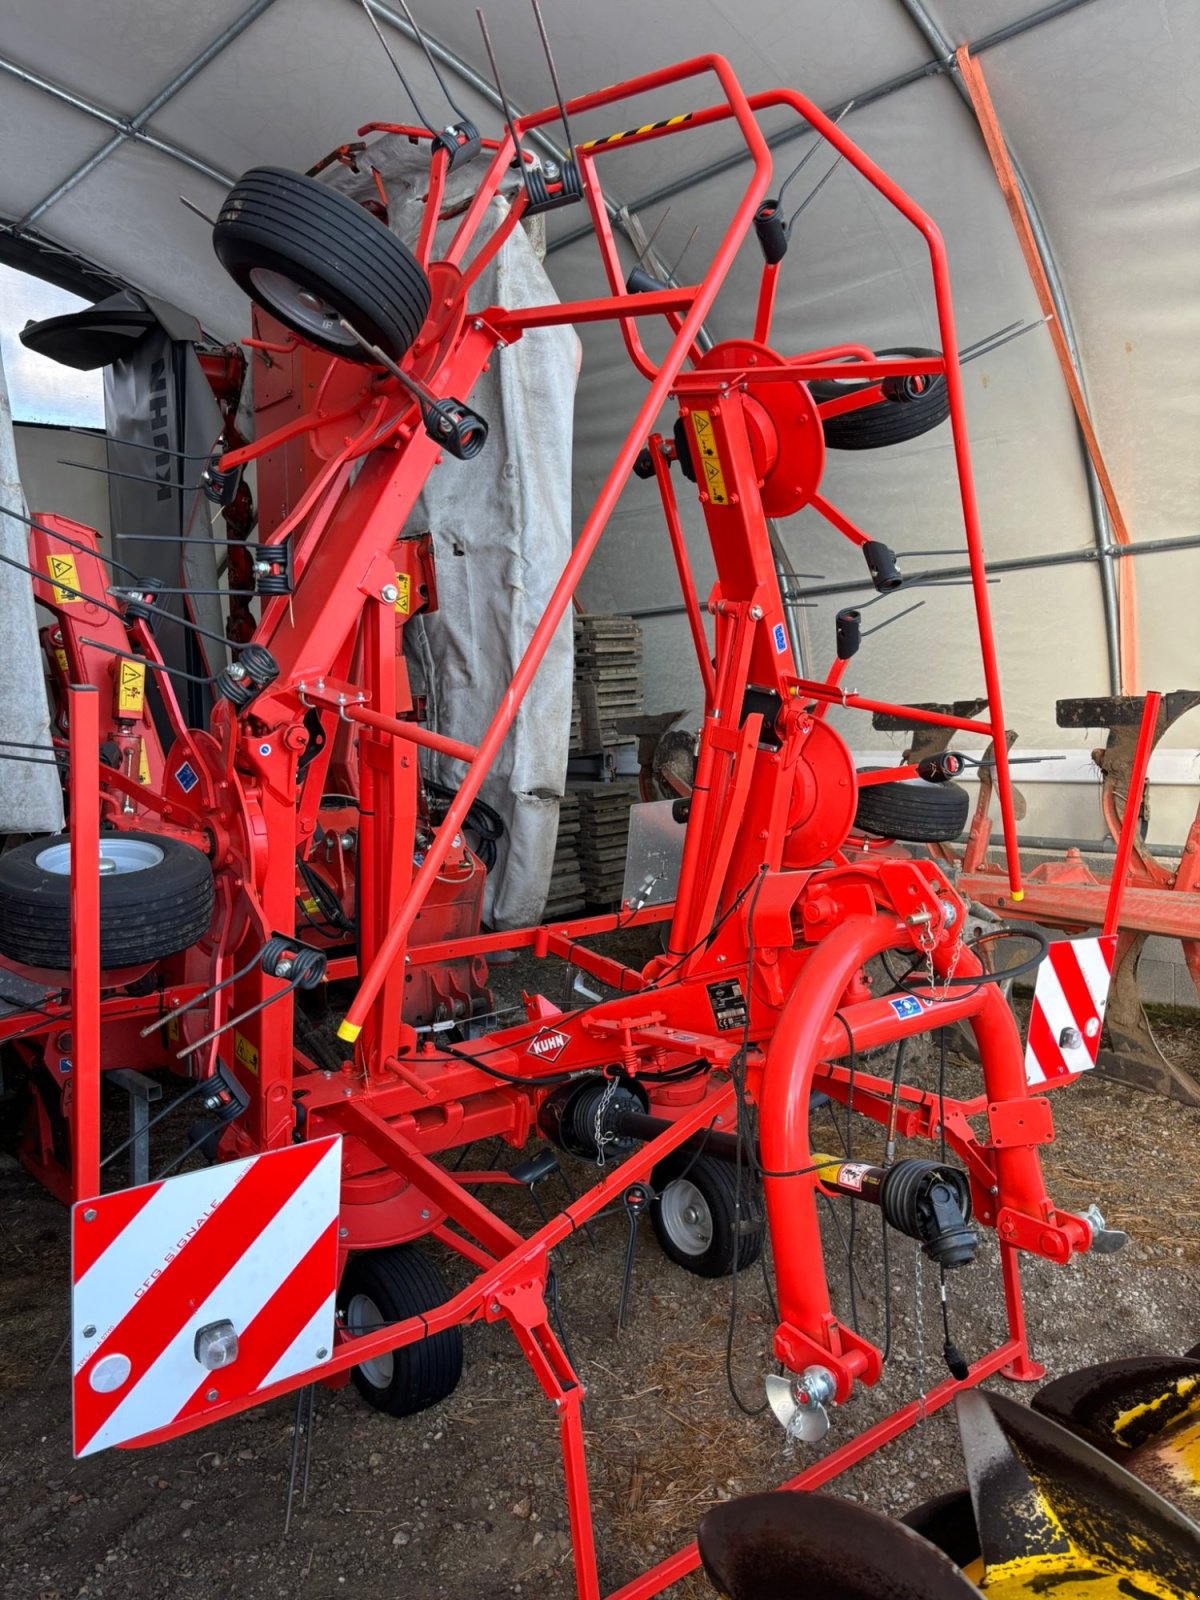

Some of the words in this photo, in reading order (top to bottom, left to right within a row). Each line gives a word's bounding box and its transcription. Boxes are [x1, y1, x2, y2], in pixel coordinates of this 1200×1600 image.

[150, 358, 171, 501] KUHN
[533, 1035, 564, 1054] KUHN
[134, 1268, 161, 1298] CFG
